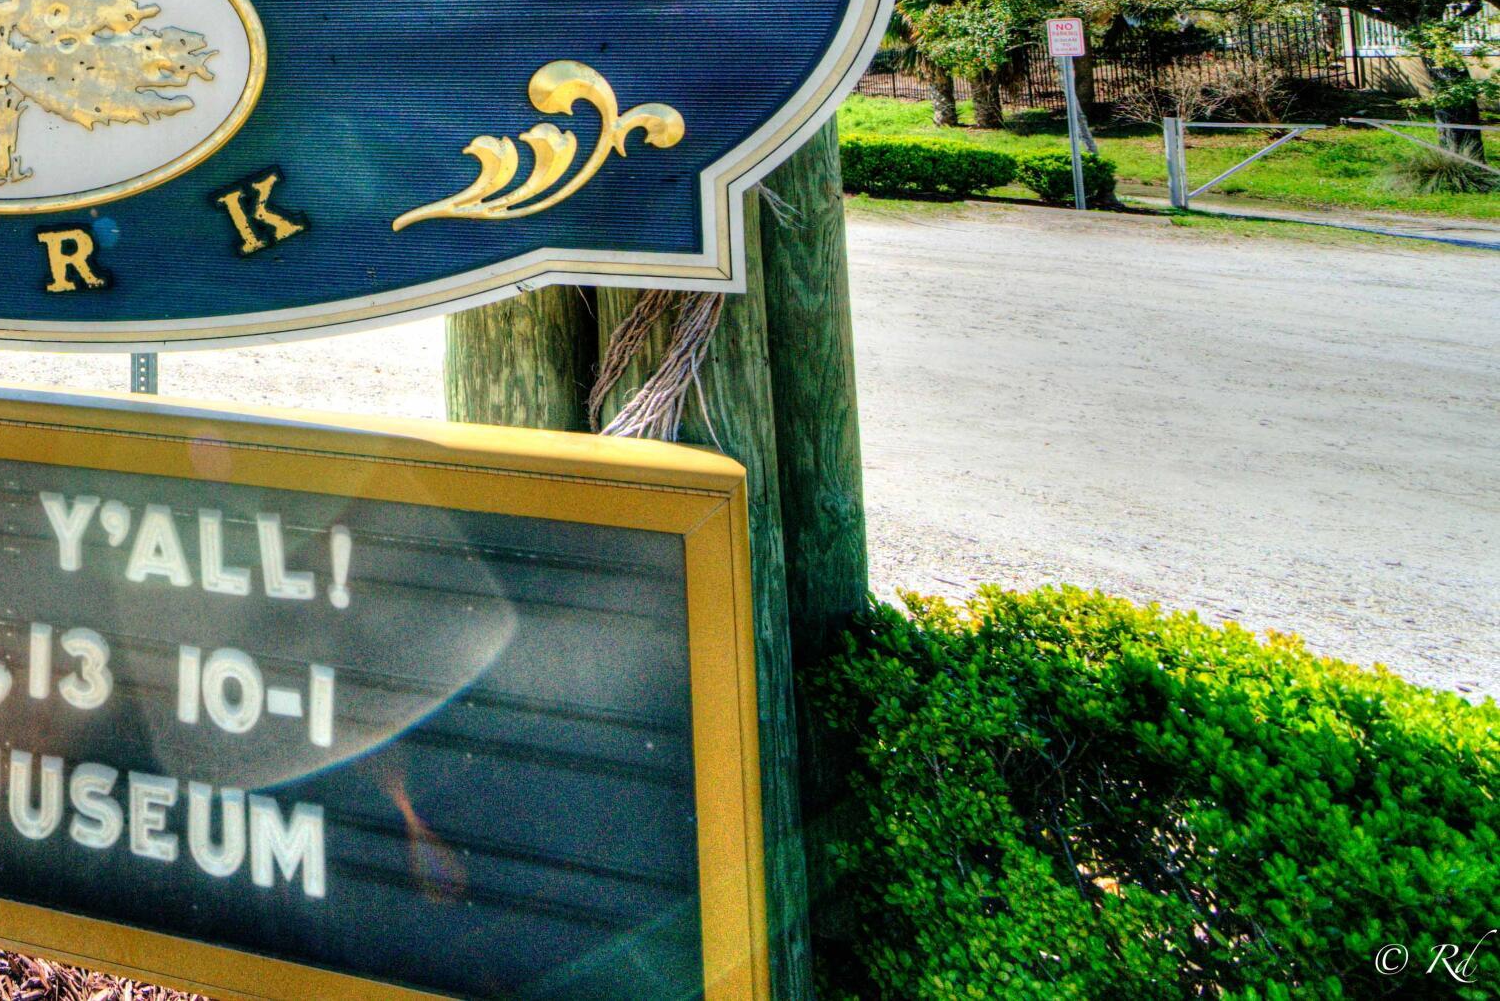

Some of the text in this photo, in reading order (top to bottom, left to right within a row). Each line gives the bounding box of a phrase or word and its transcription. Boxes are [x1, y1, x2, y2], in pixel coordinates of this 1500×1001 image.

[1055, 22, 1073, 31] NO
[39, 490, 353, 610] Y'ALL!
[177, 644, 336, 748] 10-1
